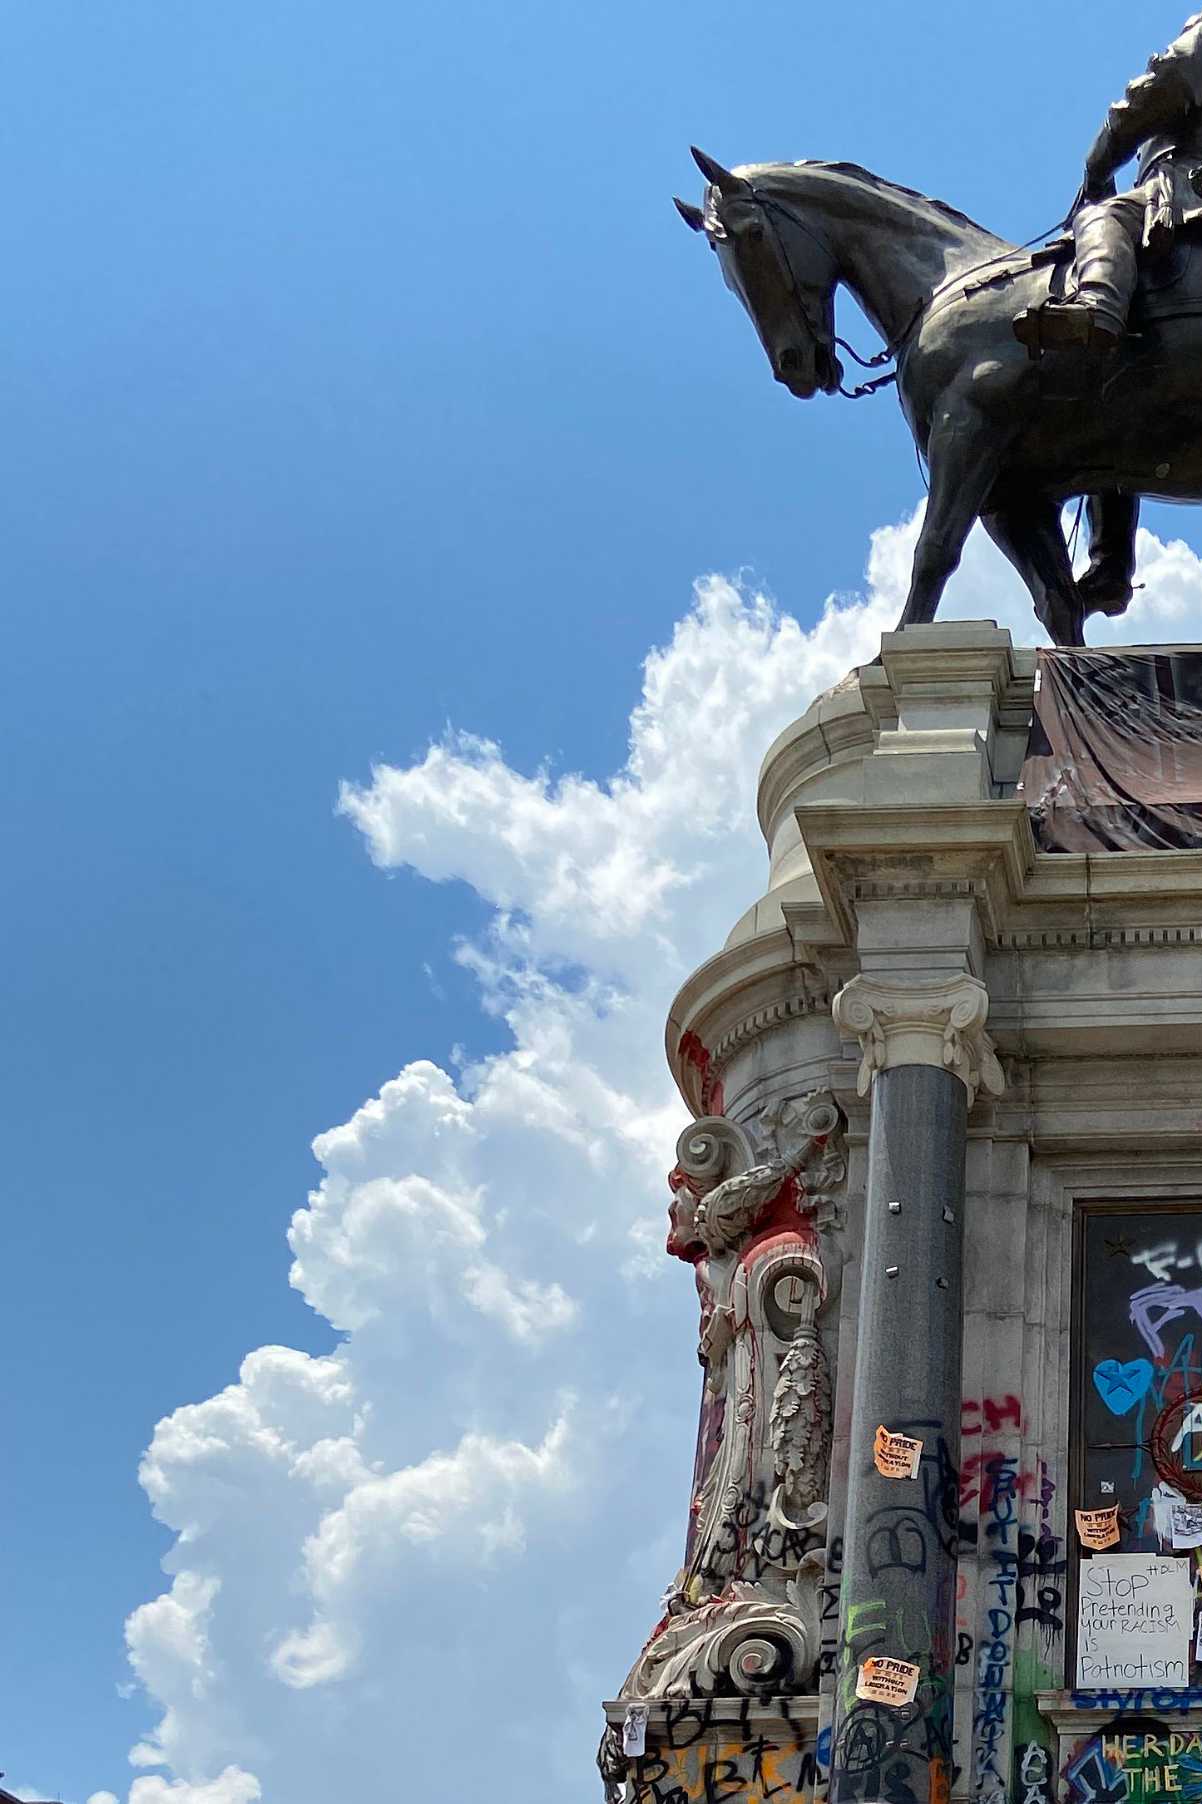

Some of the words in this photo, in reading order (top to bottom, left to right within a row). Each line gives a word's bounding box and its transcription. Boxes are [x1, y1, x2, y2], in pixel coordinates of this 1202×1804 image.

[890, 1437, 917, 1451] PRIDE
[1080, 1513, 1093, 1522] NO
[1081, 1596, 1176, 1626] Pretending
[1081, 1618, 1118, 1637] your
[1121, 1619, 1182, 1634] RACISM
[886, 1661, 915, 1676] PRIDE
[1080, 1653, 1186, 1680] Patriotism
[864, 1681, 908, 1695] LIBERATION
[872, 1675, 905, 1687] WITHOUT
[1102, 1734, 1165, 1759] HER
[1121, 1763, 1183, 1793] THE
